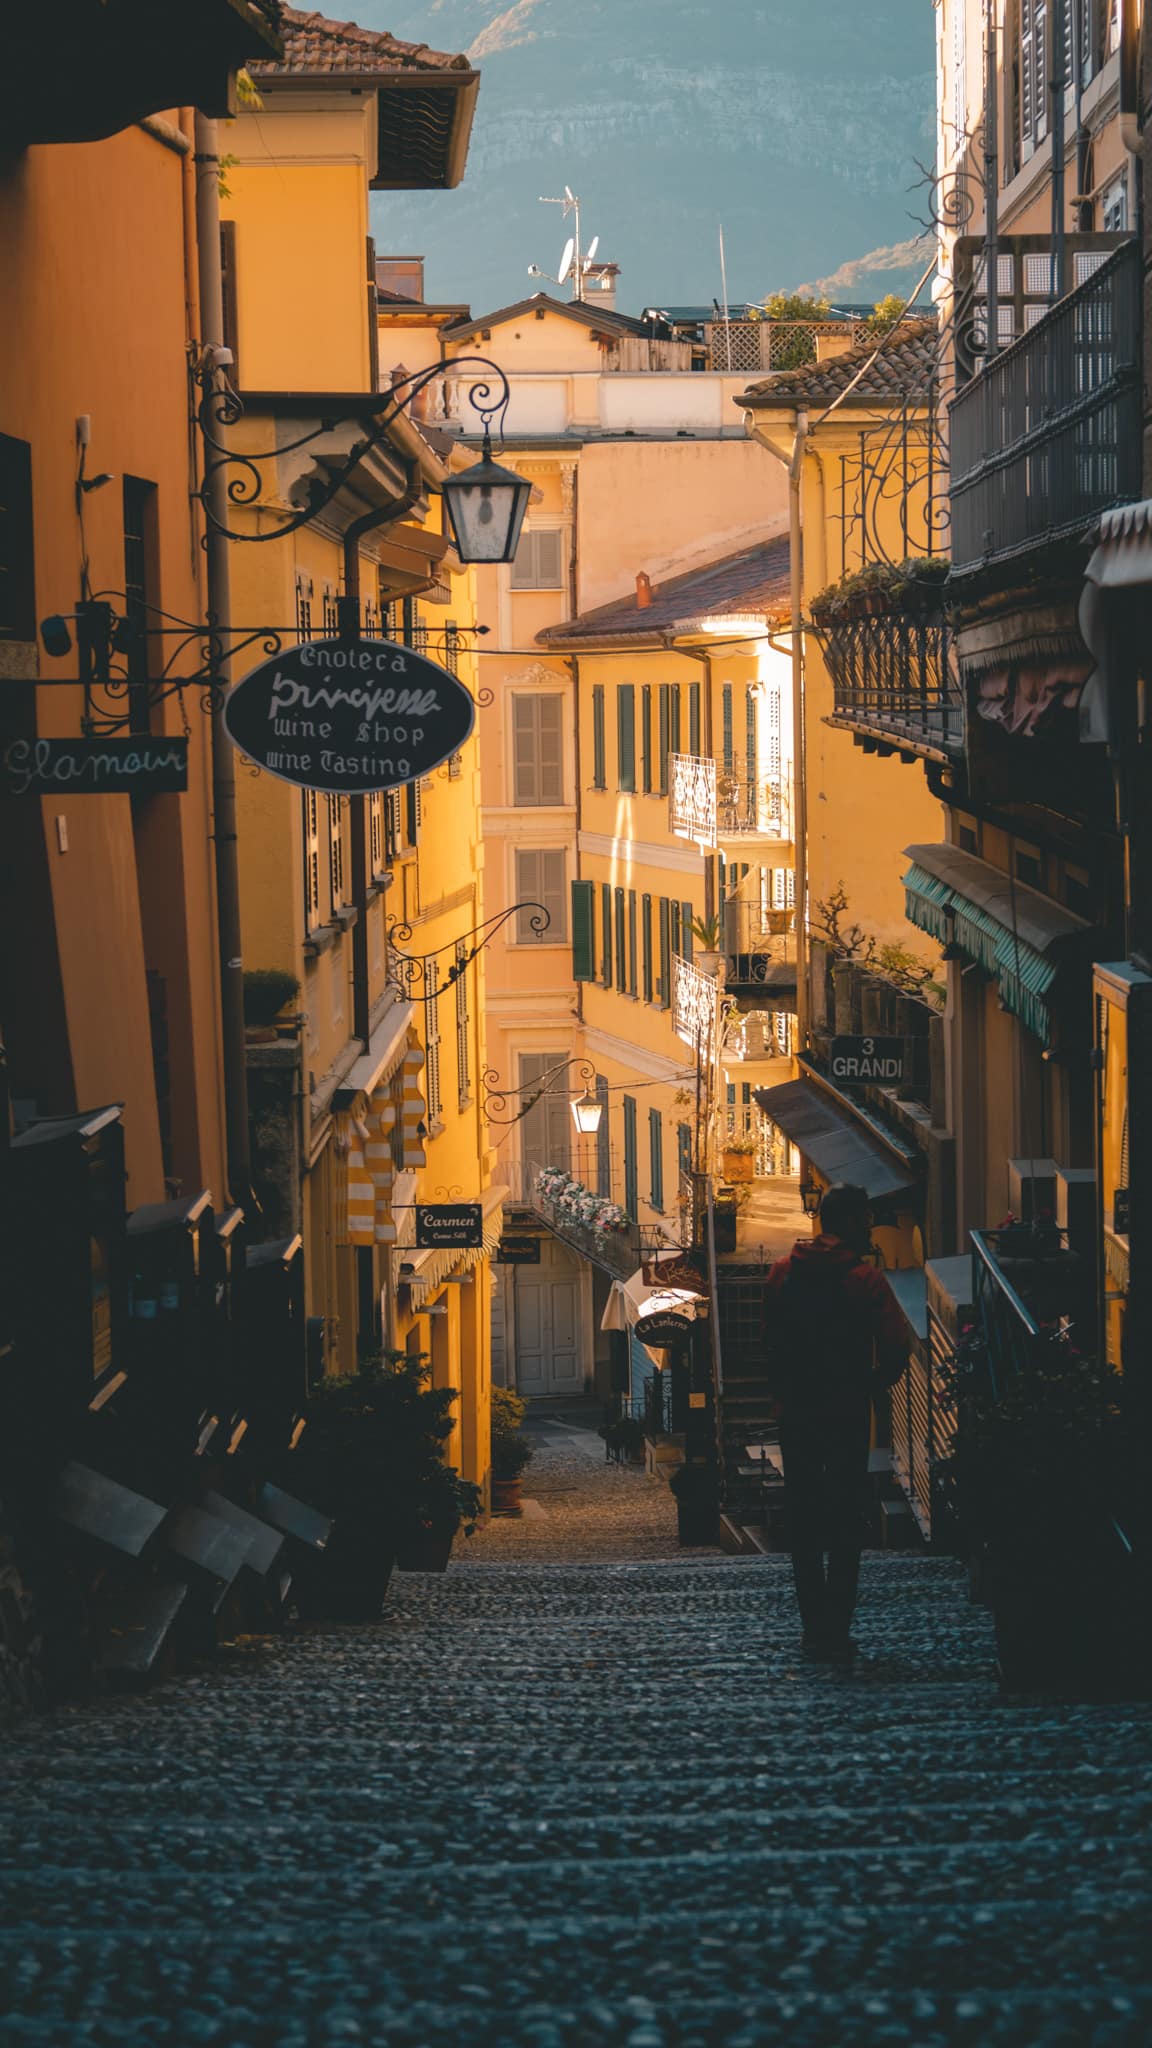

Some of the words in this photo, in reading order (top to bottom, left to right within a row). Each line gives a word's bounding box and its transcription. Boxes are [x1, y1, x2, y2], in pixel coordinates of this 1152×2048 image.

[5, 739, 186, 795] Glamour
[320, 749, 411, 778] Tasting
[863, 1038, 875, 1055] 3
[832, 1057, 902, 1078] GRANDI
[423, 1214, 475, 1227] Carmen
